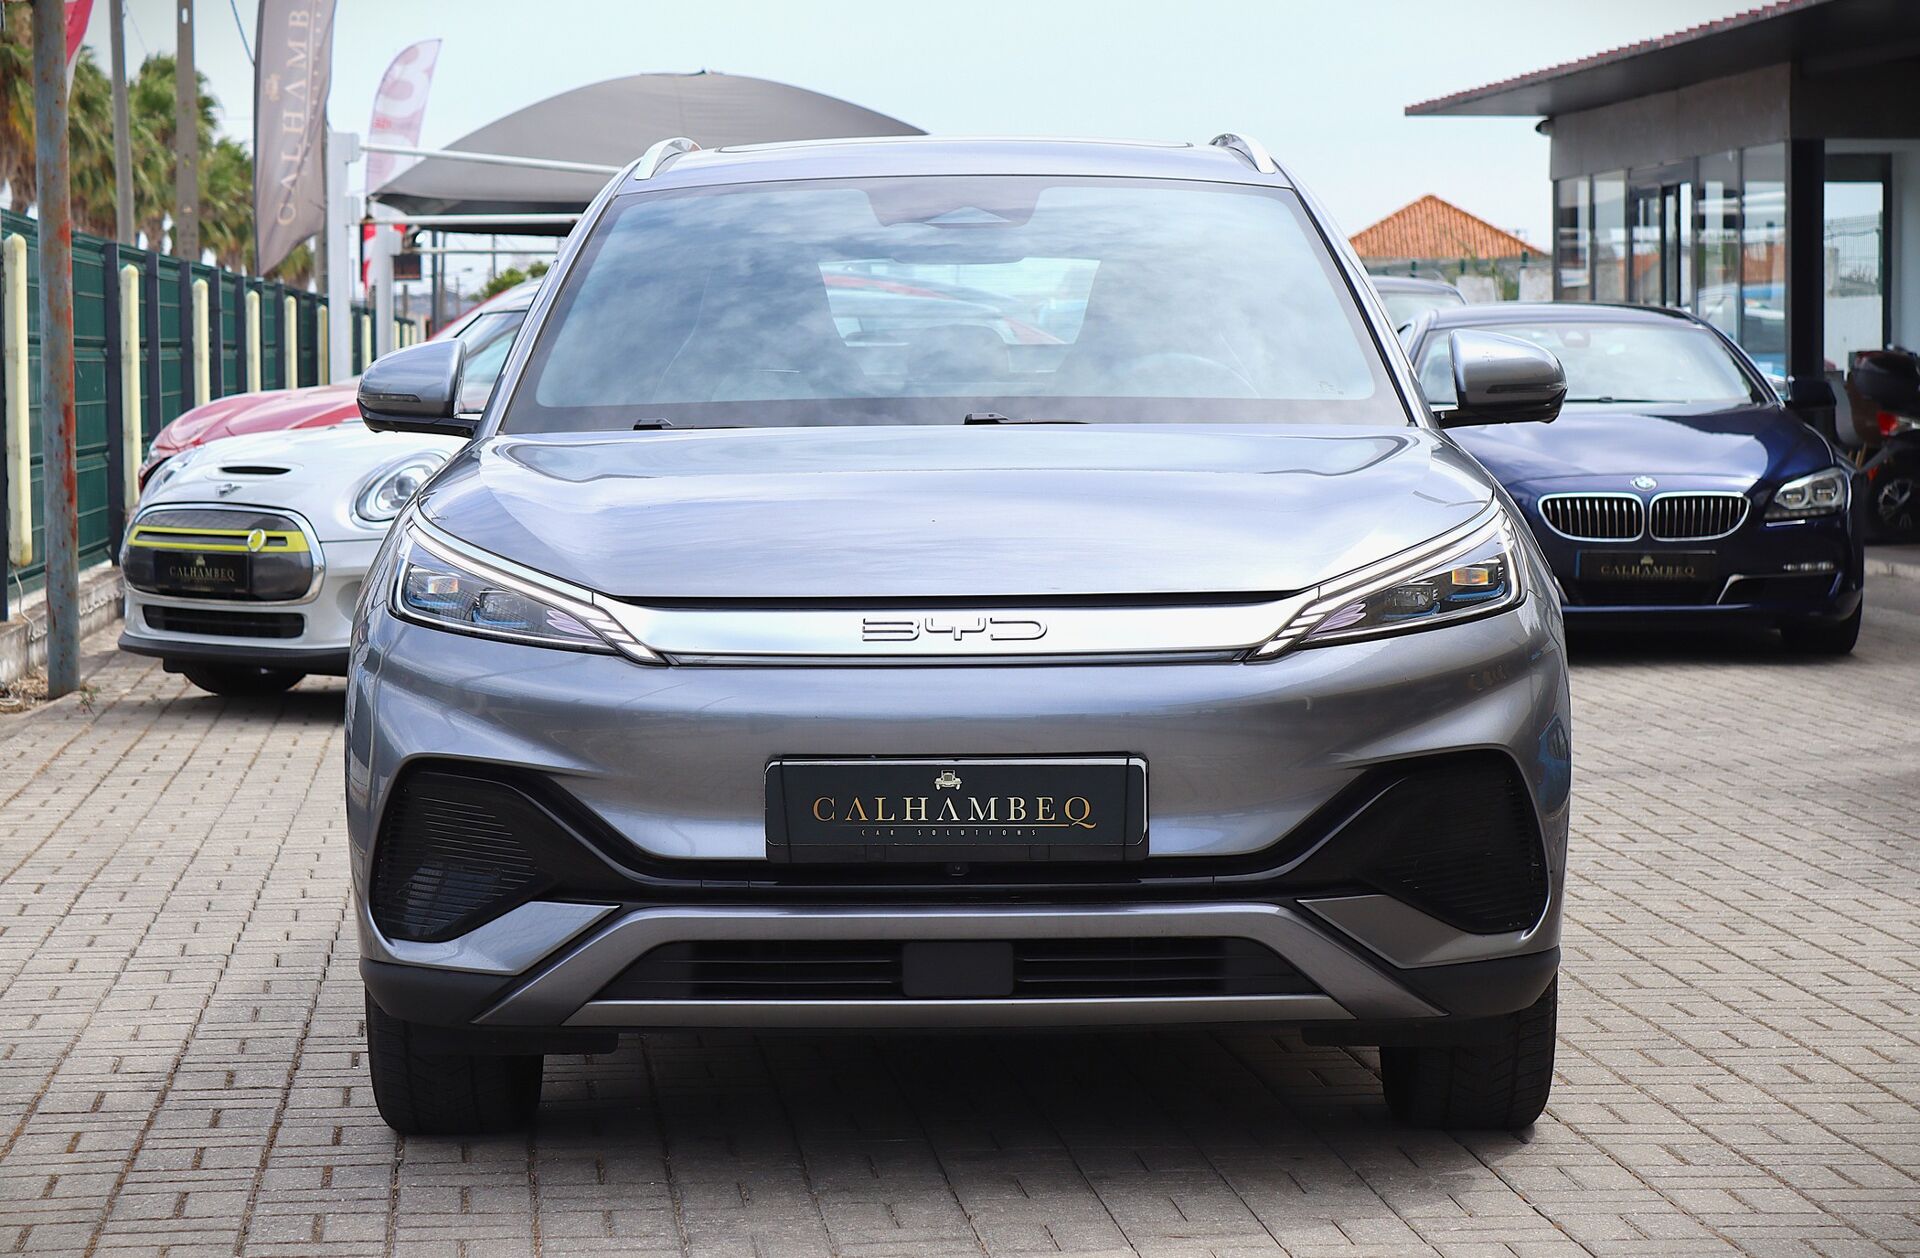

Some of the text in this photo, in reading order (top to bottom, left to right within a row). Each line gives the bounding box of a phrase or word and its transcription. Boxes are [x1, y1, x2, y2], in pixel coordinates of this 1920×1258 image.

[277, 2, 309, 226] CALHAMB
[169, 566, 235, 582] CALHAMBEQ
[1601, 564, 1696, 577] CALHAMBEQ
[861, 617, 1048, 642] BYD
[812, 796, 1097, 829] CALHAMBEQ
